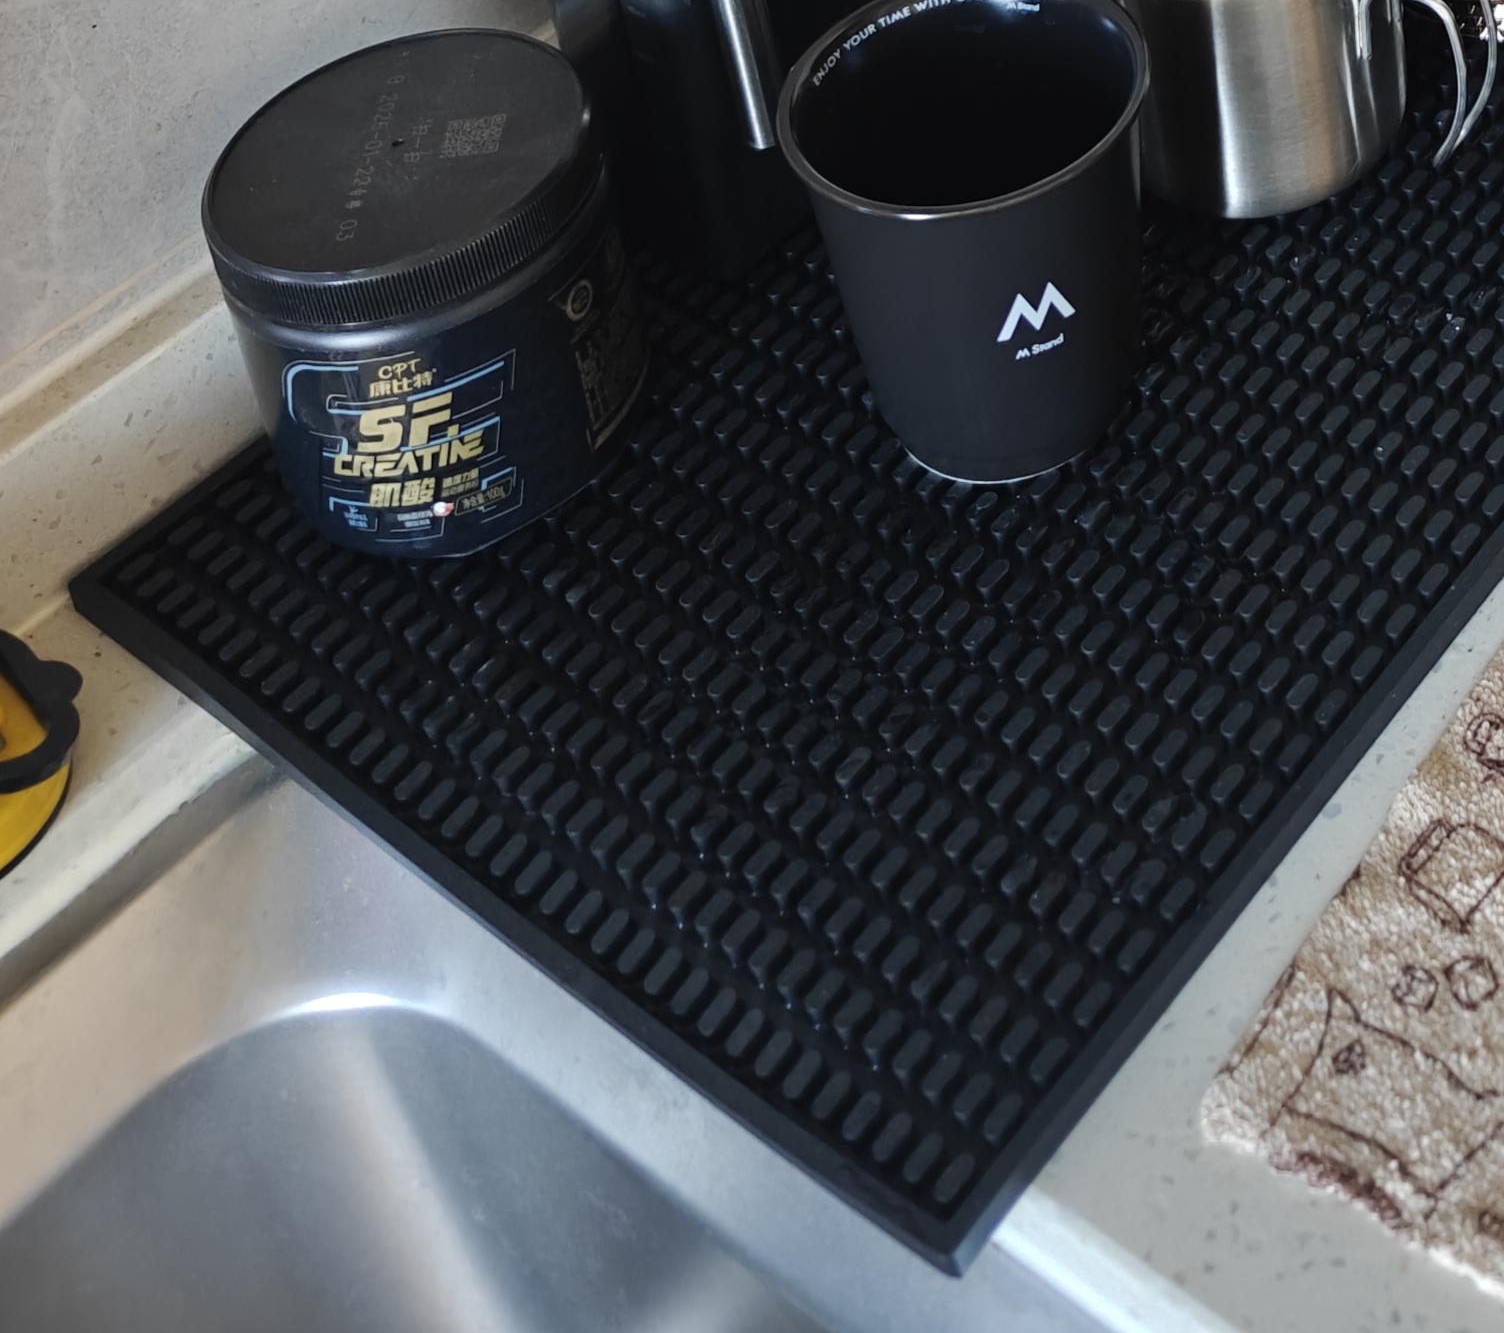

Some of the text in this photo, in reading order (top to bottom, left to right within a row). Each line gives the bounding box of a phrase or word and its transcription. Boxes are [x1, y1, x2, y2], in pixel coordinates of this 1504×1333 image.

[811, 48, 842, 87] ENJOY
[842, 23, 877, 51] YOUR
[877, 5, 912, 29] TIME
[368, 370, 432, 398] 康比特
[377, 357, 422, 380] CPT
[356, 391, 454, 454] SF
[333, 423, 485, 479] CREATINE
[368, 477, 436, 508] 肌酸
